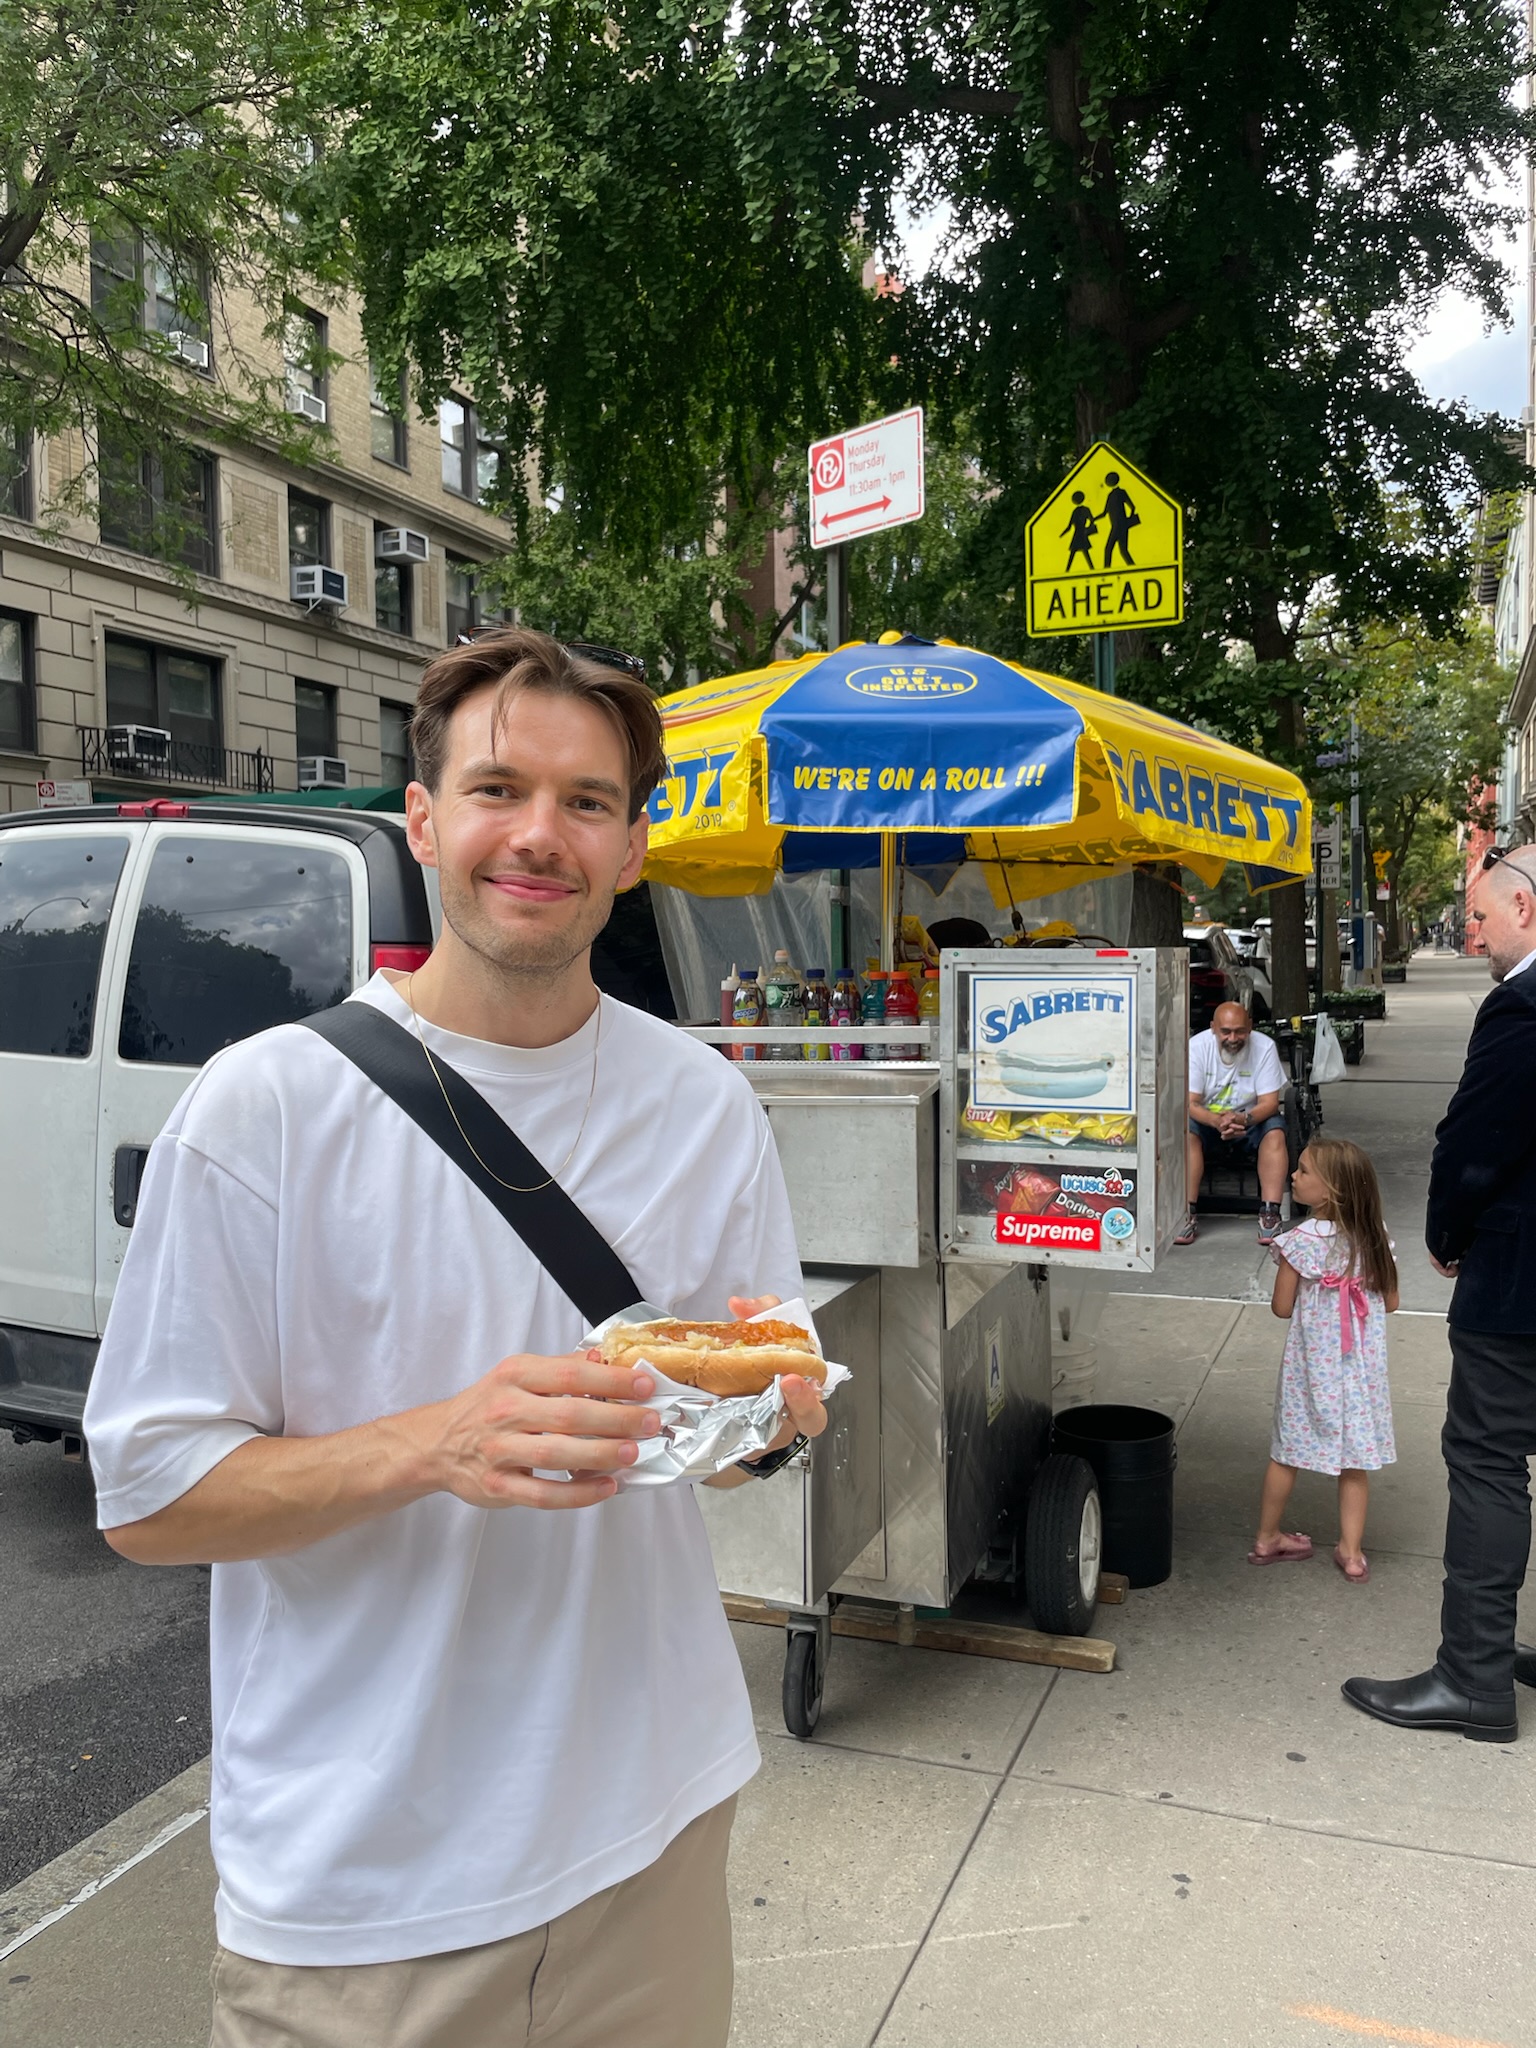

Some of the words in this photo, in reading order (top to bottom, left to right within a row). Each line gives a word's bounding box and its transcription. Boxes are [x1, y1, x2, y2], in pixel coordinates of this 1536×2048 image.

[848, 440, 879, 458] Monday
[849, 454, 886, 474] Thursday
[849, 478, 881, 496] 11:30am
[889, 470, 905, 486] 1pm
[1047, 578, 1163, 620] AHEAD
[881, 676, 942, 685] GOV'T
[889, 668, 929, 676] U.S.
[862, 683, 965, 692] INSPECTED
[793, 766, 871, 791] WE'RE
[878, 767, 914, 790] ON
[920, 767, 936, 790] A
[945, 767, 1006, 792] ROLL
[694, 813, 722, 829] 2019
[980, 987, 1124, 1043] SABRETT
[1055, 1192, 1102, 1220] Doritos
[1001, 1216, 1094, 1243] Supreme
